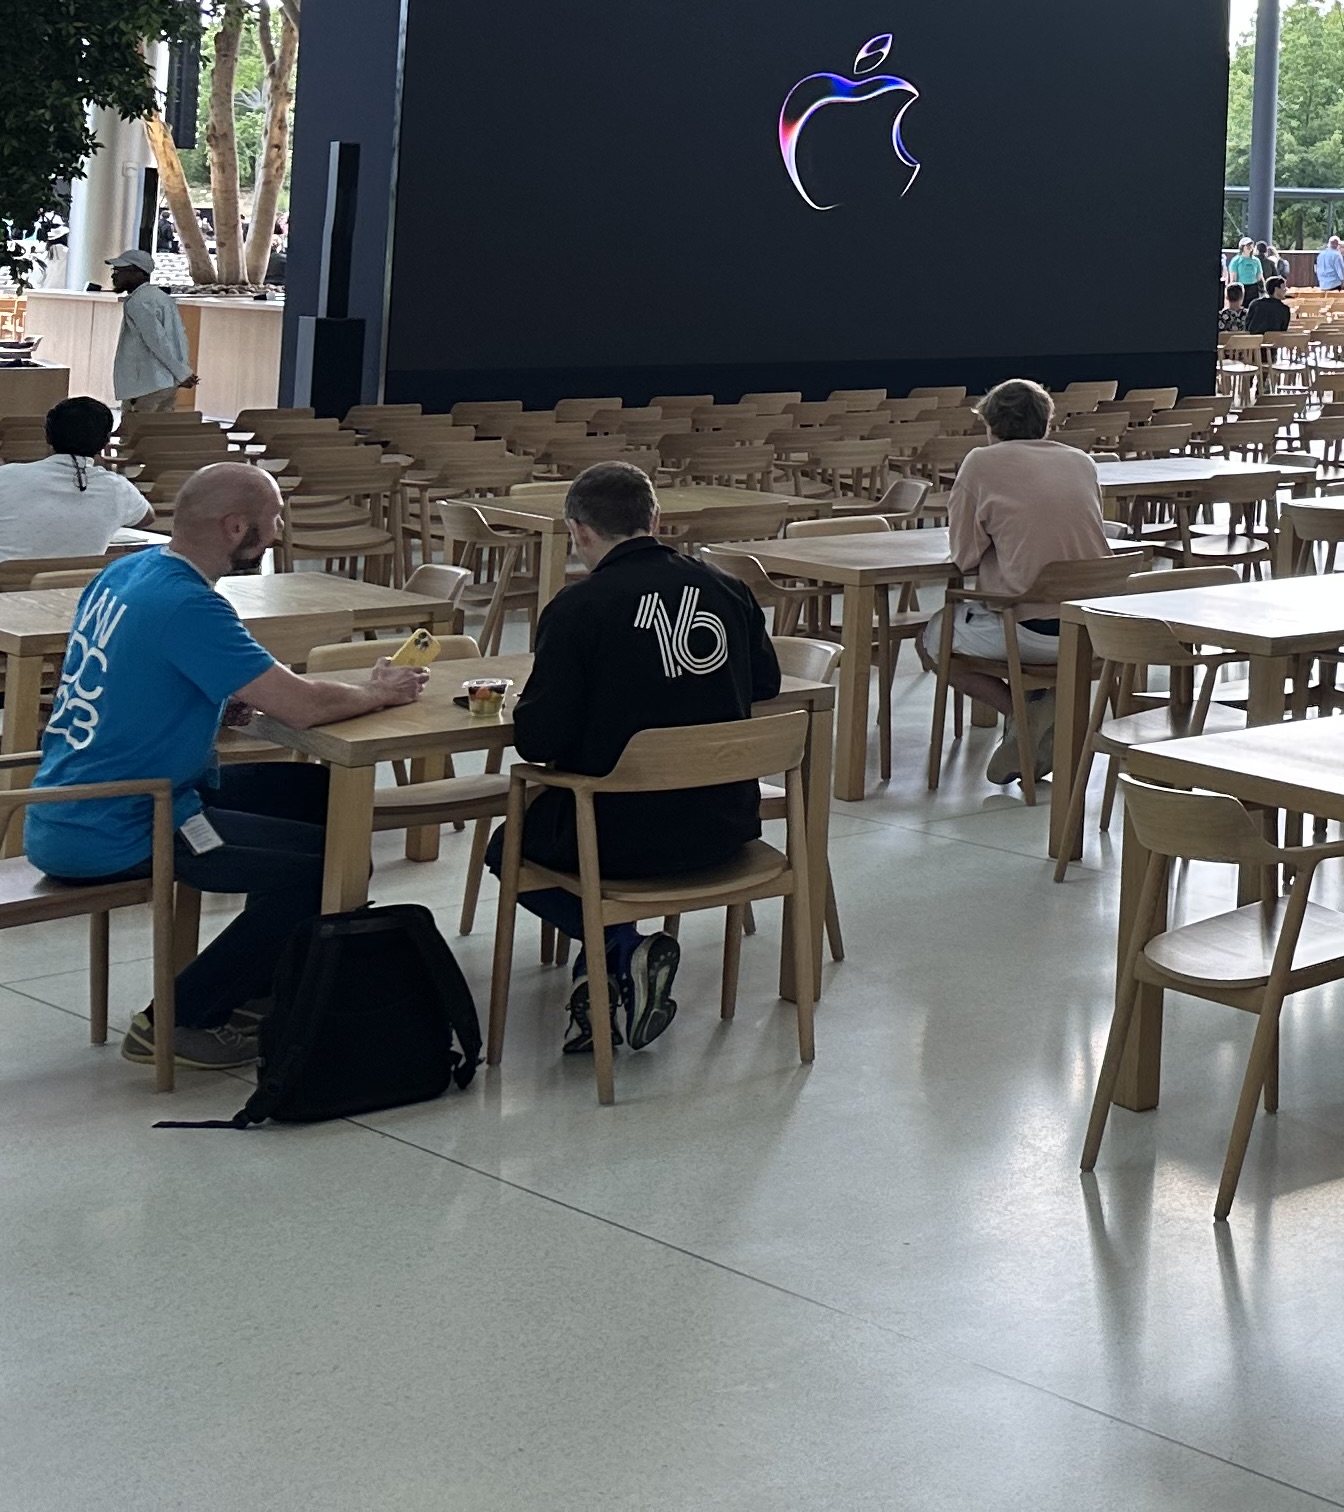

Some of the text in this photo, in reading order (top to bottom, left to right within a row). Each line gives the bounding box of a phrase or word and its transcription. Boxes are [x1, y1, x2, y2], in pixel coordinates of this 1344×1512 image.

[61, 630, 107, 700] DC
[634, 585, 728, 678] 16
[46, 684, 99, 750] 23
